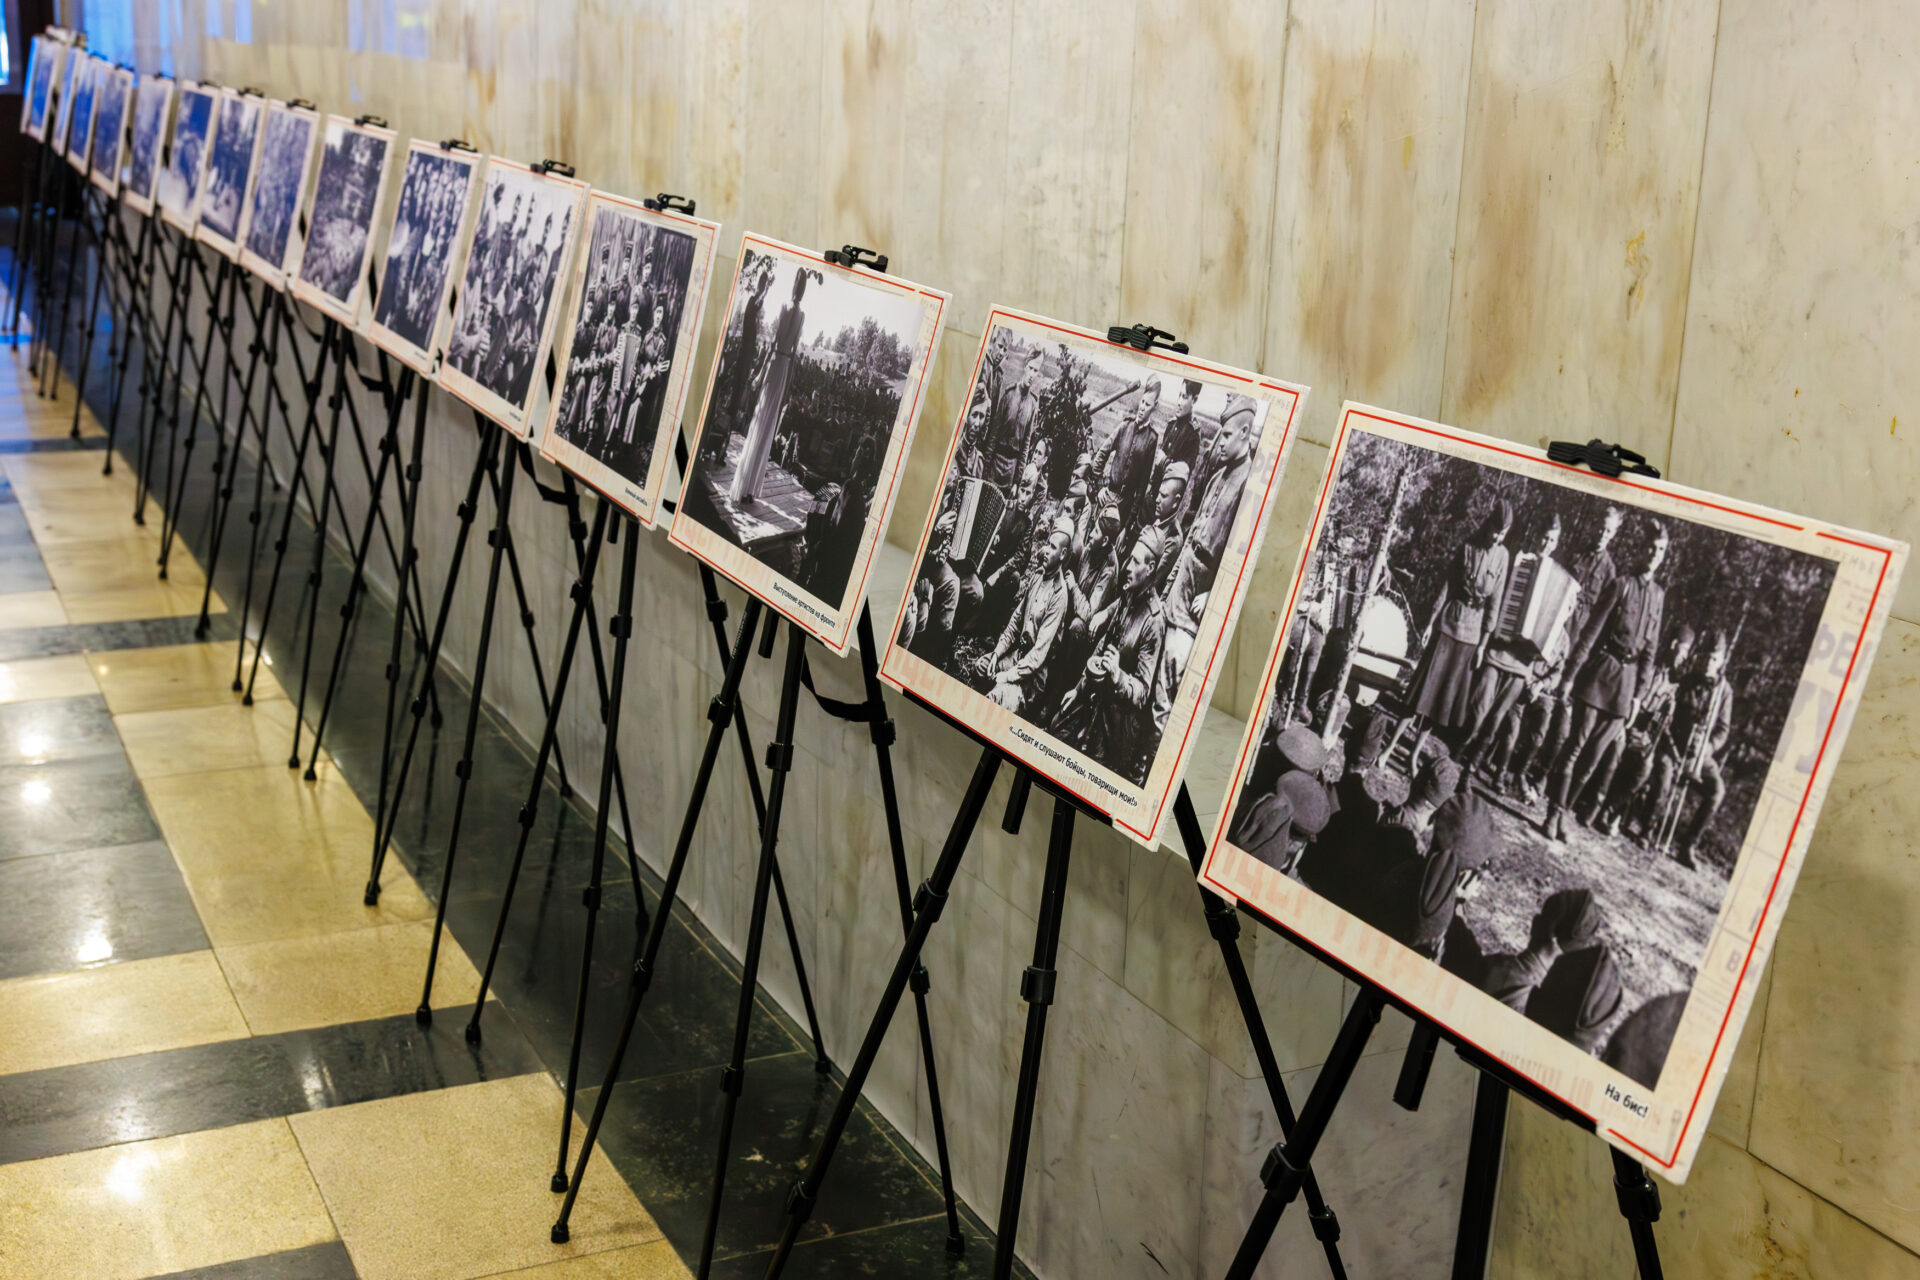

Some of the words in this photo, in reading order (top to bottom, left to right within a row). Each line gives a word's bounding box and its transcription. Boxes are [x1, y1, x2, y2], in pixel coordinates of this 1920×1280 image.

[1033, 739, 1040, 749] и
[1038, 743, 1066, 764] слушают
[1065, 757, 1087, 779] бойцы,
[1087, 772, 1119, 797] товарищи
[1604, 1083, 1621, 1102] На
[1622, 1094, 1649, 1119] бис!
